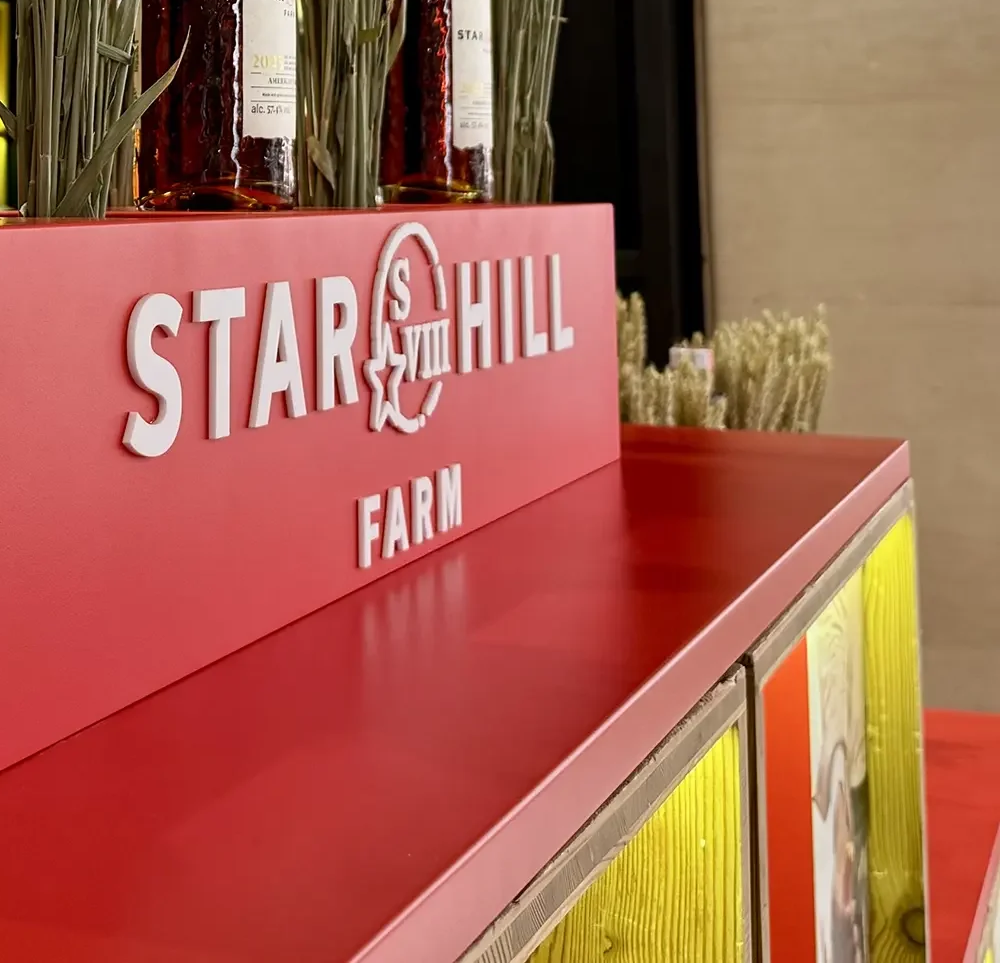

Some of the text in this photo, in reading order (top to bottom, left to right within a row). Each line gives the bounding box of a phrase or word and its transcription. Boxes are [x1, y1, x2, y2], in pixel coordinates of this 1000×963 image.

[457, 29, 484, 41] STAR
[251, 103, 266, 114] alc.
[387, 257, 412, 321] S
[121, 253, 575, 458] STAR HILL
[403, 318, 452, 382] VIII
[356, 463, 463, 569] FARM
